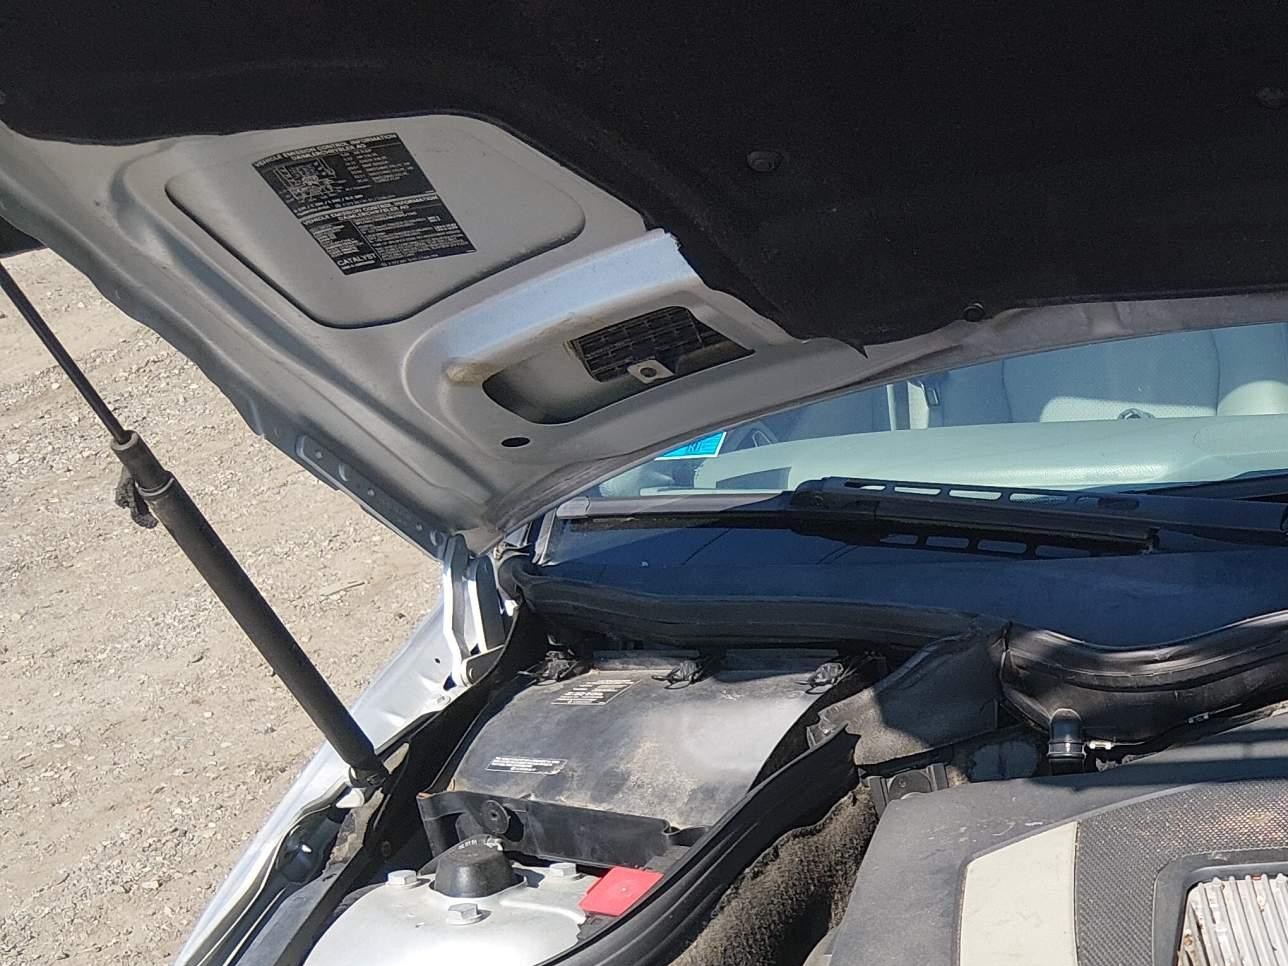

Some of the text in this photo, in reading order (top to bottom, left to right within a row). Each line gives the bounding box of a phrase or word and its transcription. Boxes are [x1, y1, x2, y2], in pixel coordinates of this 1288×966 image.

[254, 133, 397, 167] VEHICLE EMISSION CONTROL INFORMATION
[302, 214, 332, 225] VEHICLE
[363, 203, 392, 213] CONTROL
[393, 195, 438, 206] INFORMATION
[337, 253, 377, 267] CATALYST
